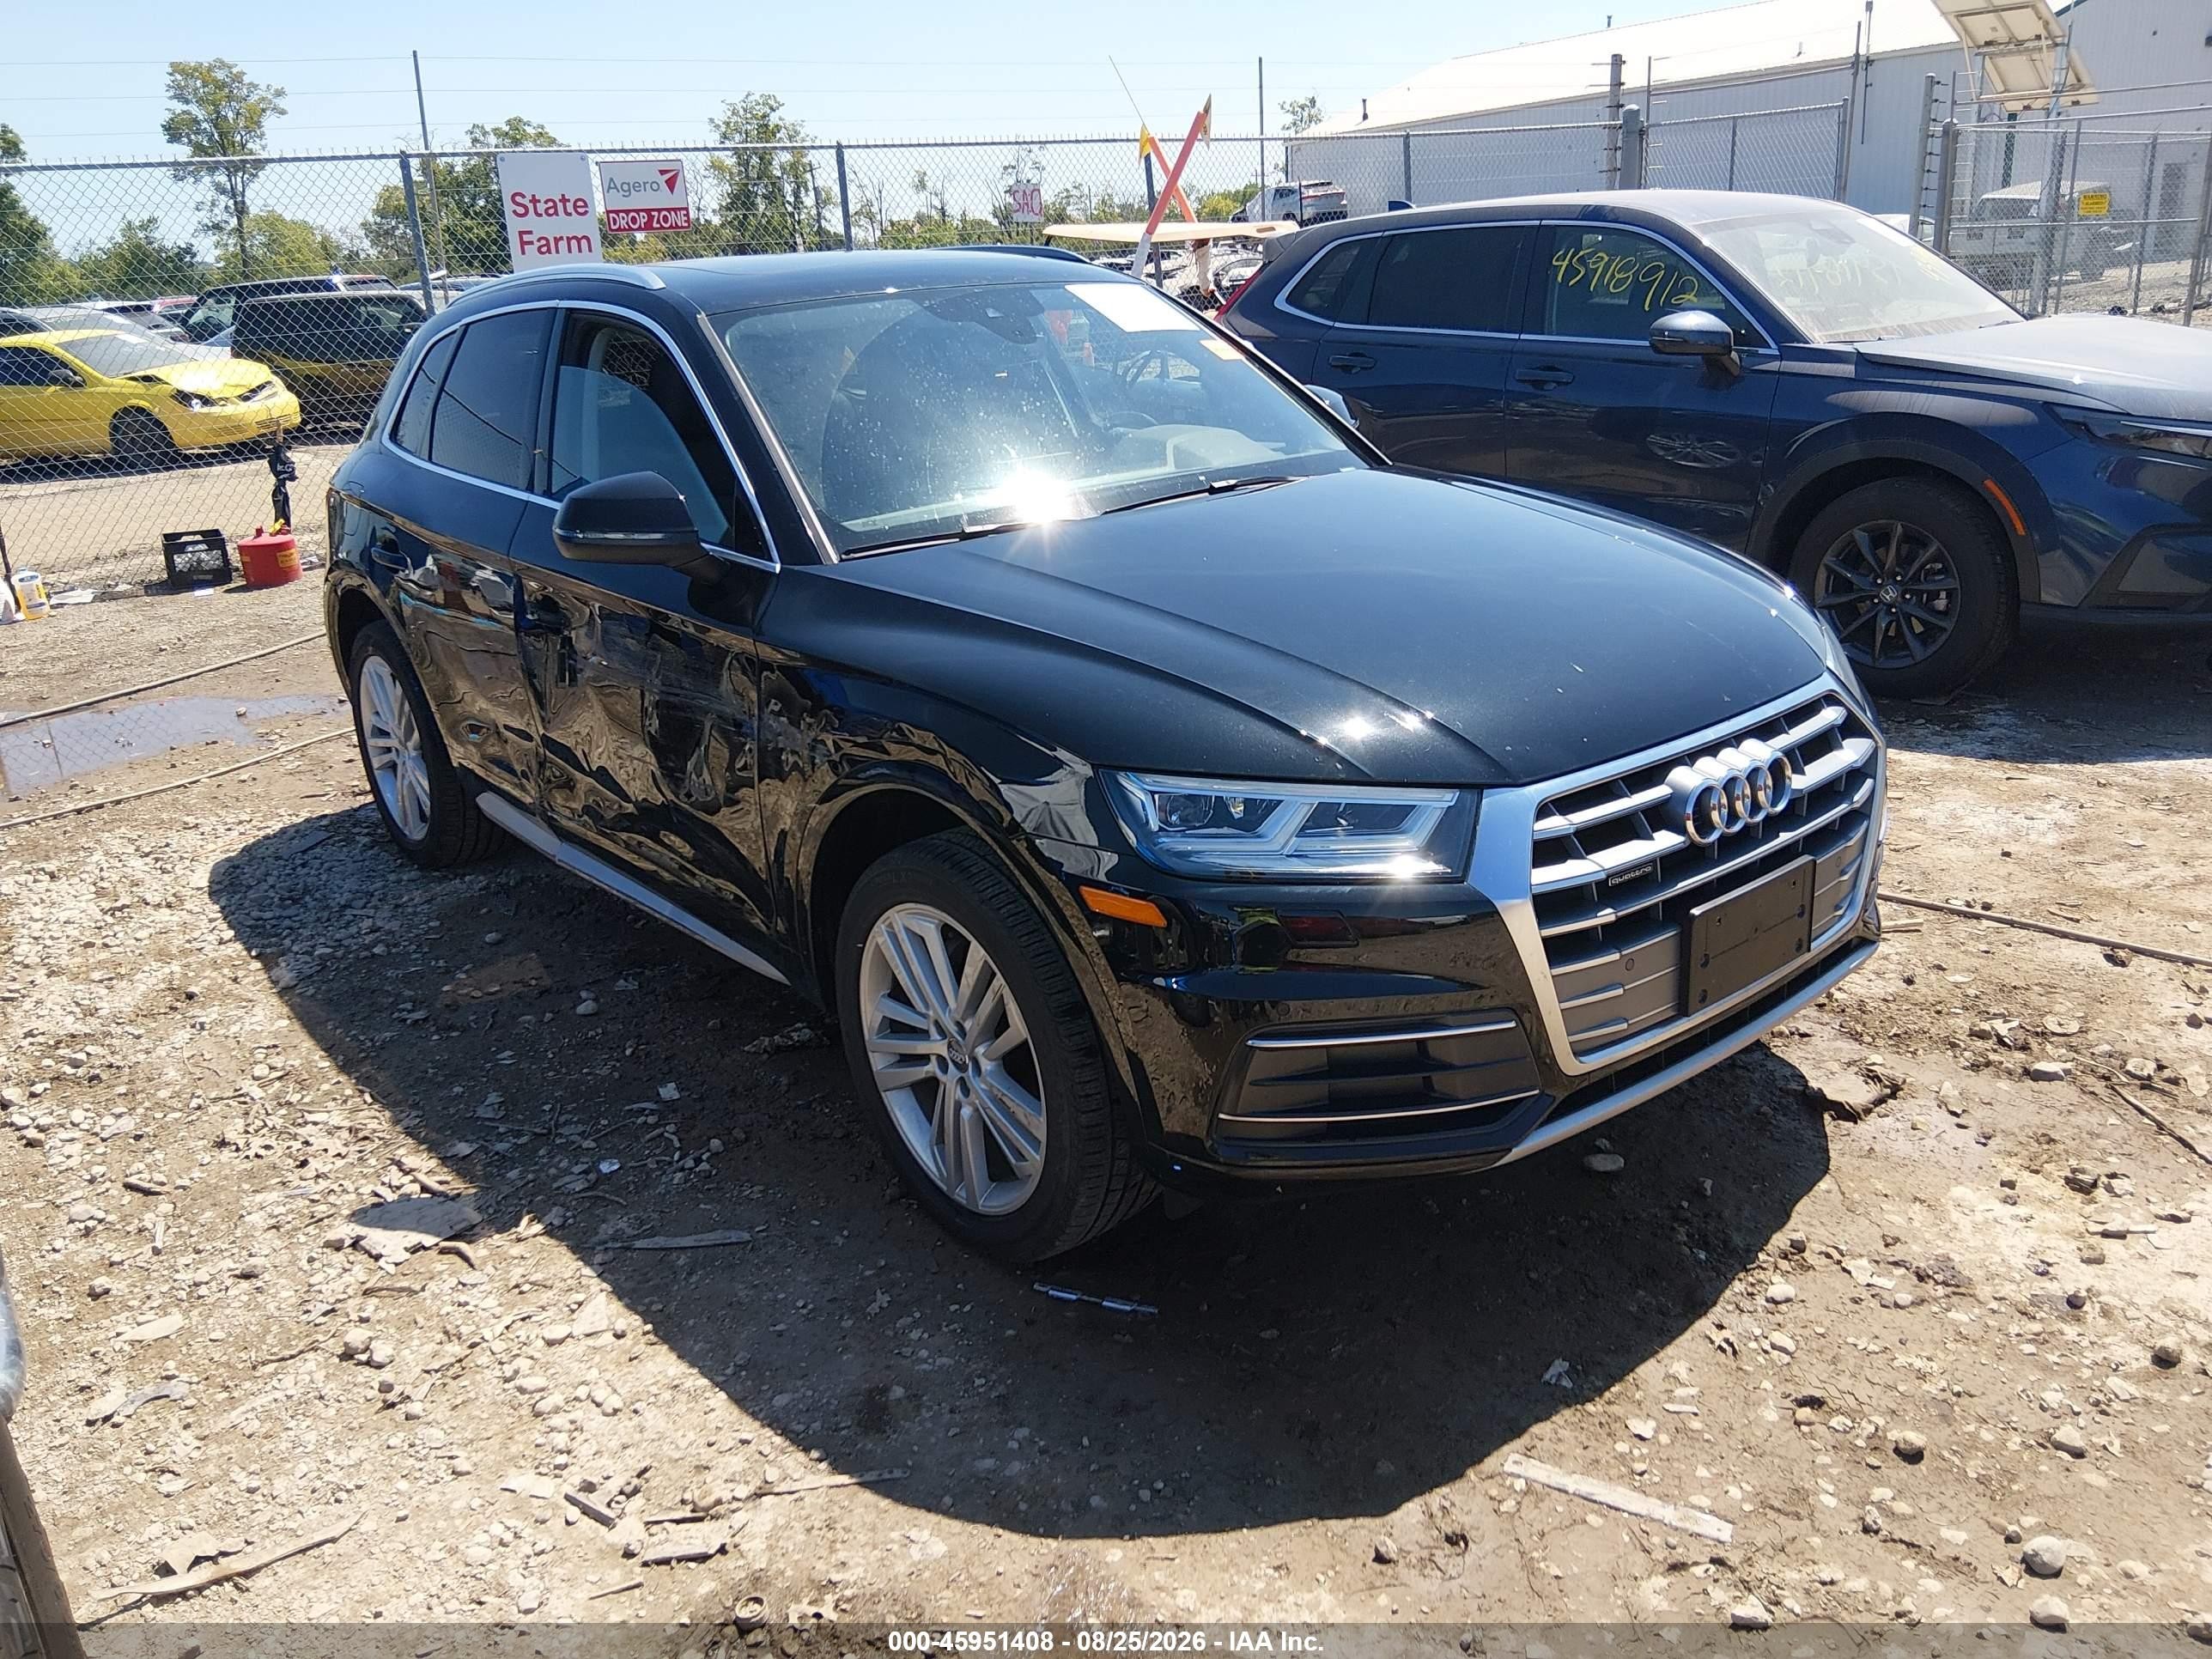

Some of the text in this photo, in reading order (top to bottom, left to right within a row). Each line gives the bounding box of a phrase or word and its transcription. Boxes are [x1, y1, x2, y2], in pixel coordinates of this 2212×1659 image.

[606, 177, 660, 198] Agero
[510, 191, 590, 218] State
[609, 210, 690, 230] DROP ZONE
[518, 229, 592, 256] Farm
[1552, 247, 1699, 312] 45918912
[1611, 866, 1652, 884] quattro
